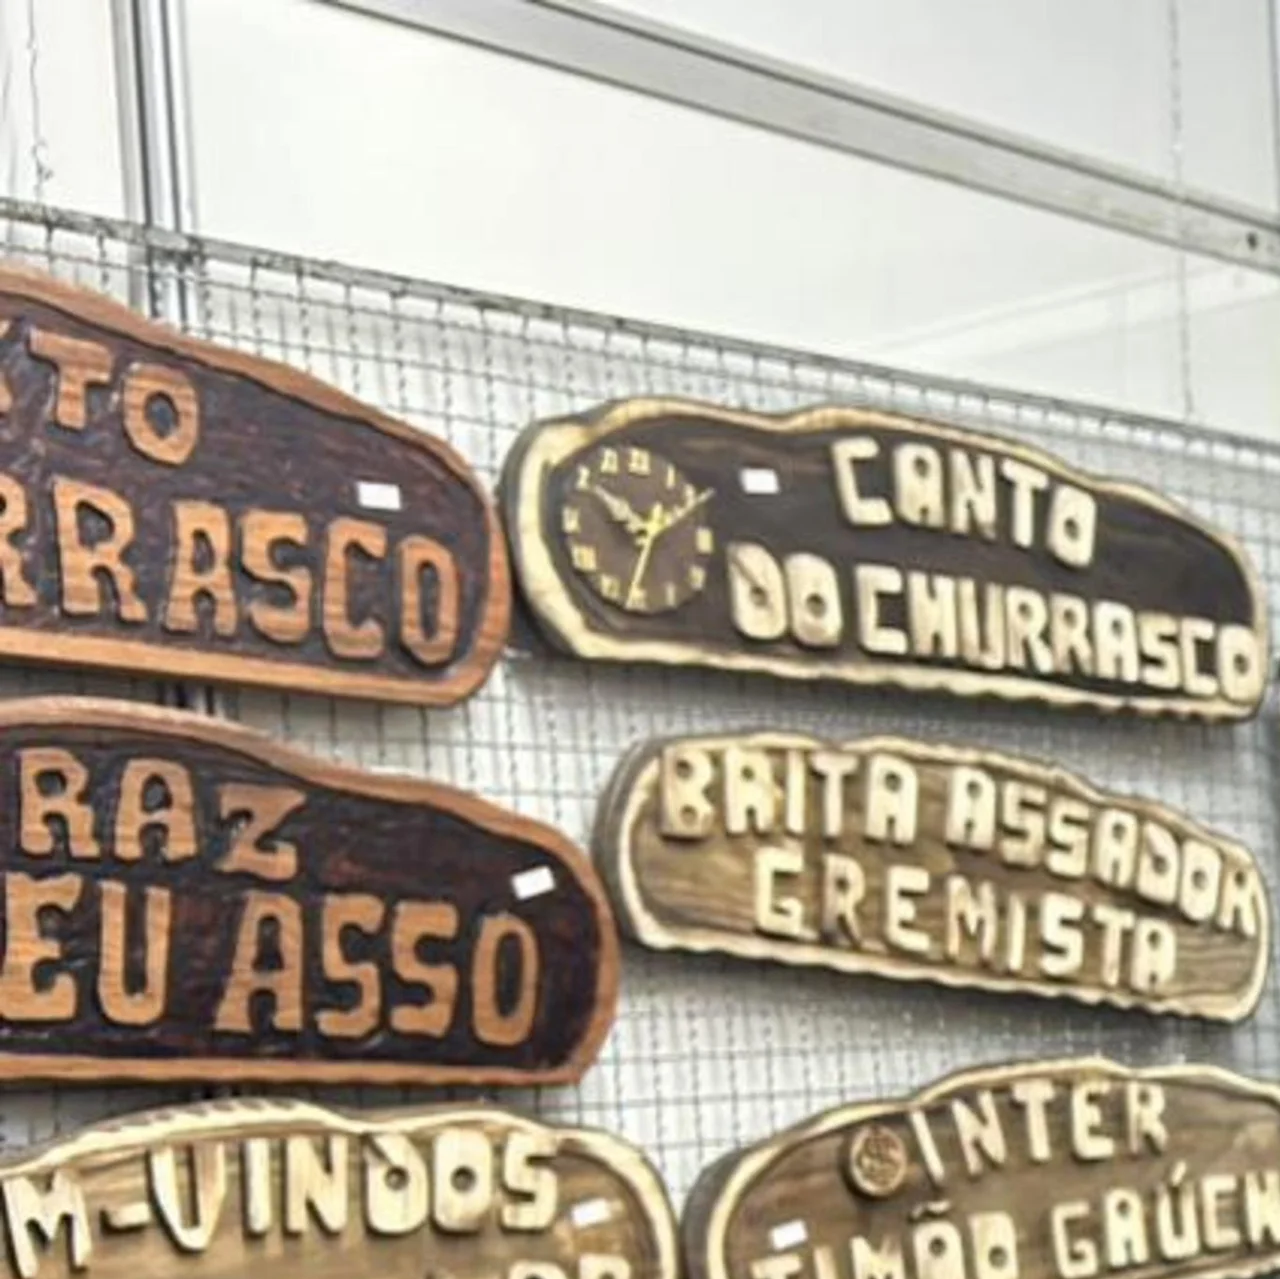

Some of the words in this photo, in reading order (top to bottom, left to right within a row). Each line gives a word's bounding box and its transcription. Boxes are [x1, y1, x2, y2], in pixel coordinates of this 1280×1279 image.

[0, 318, 198, 466] TO
[830, 437, 1097, 568] CANTO
[726, 541, 844, 649] DO
[856, 564, 1260, 700] CHURRASCO
[18, 747, 306, 881] RAZ
[660, 746, 918, 843] BAITA
[945, 766, 1258, 936] ASSADOR
[0, 871, 171, 1026] EU
[212, 890, 539, 1046] ASSO
[754, 846, 1178, 991] GREMISTA
[910, 1079, 1168, 1189] INTER
